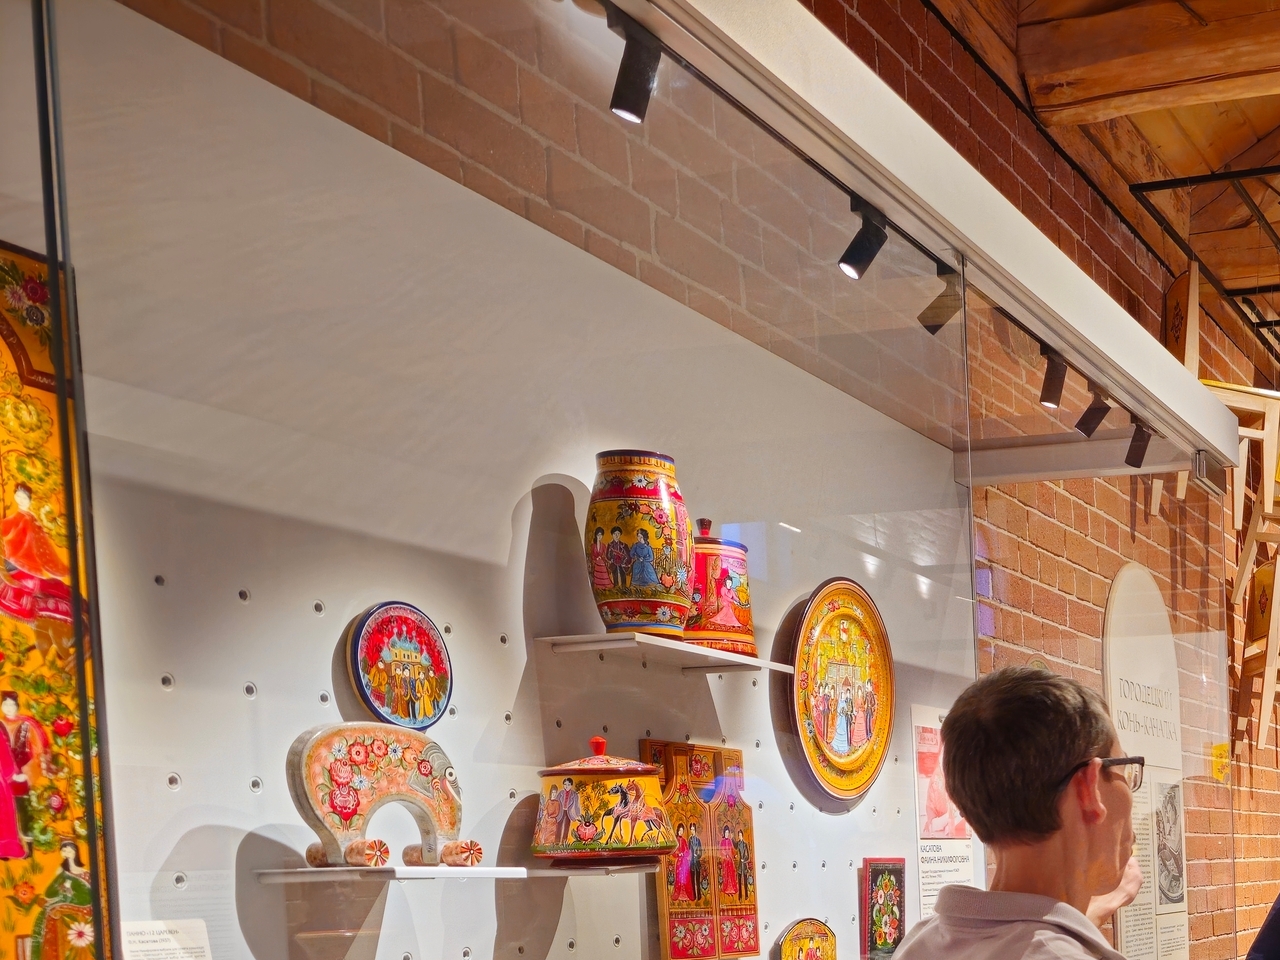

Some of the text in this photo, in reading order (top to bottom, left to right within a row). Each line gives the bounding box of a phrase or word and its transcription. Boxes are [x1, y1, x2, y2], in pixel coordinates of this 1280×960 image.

[1119, 677, 1173, 711] ГОРОДЕЦКИЙ
[1116, 709, 1178, 742] КОНЬ-КАЧАЛКА
[920, 844, 942, 853] КАСАТОВА
[126, 930, 146, 938] ПАННО
